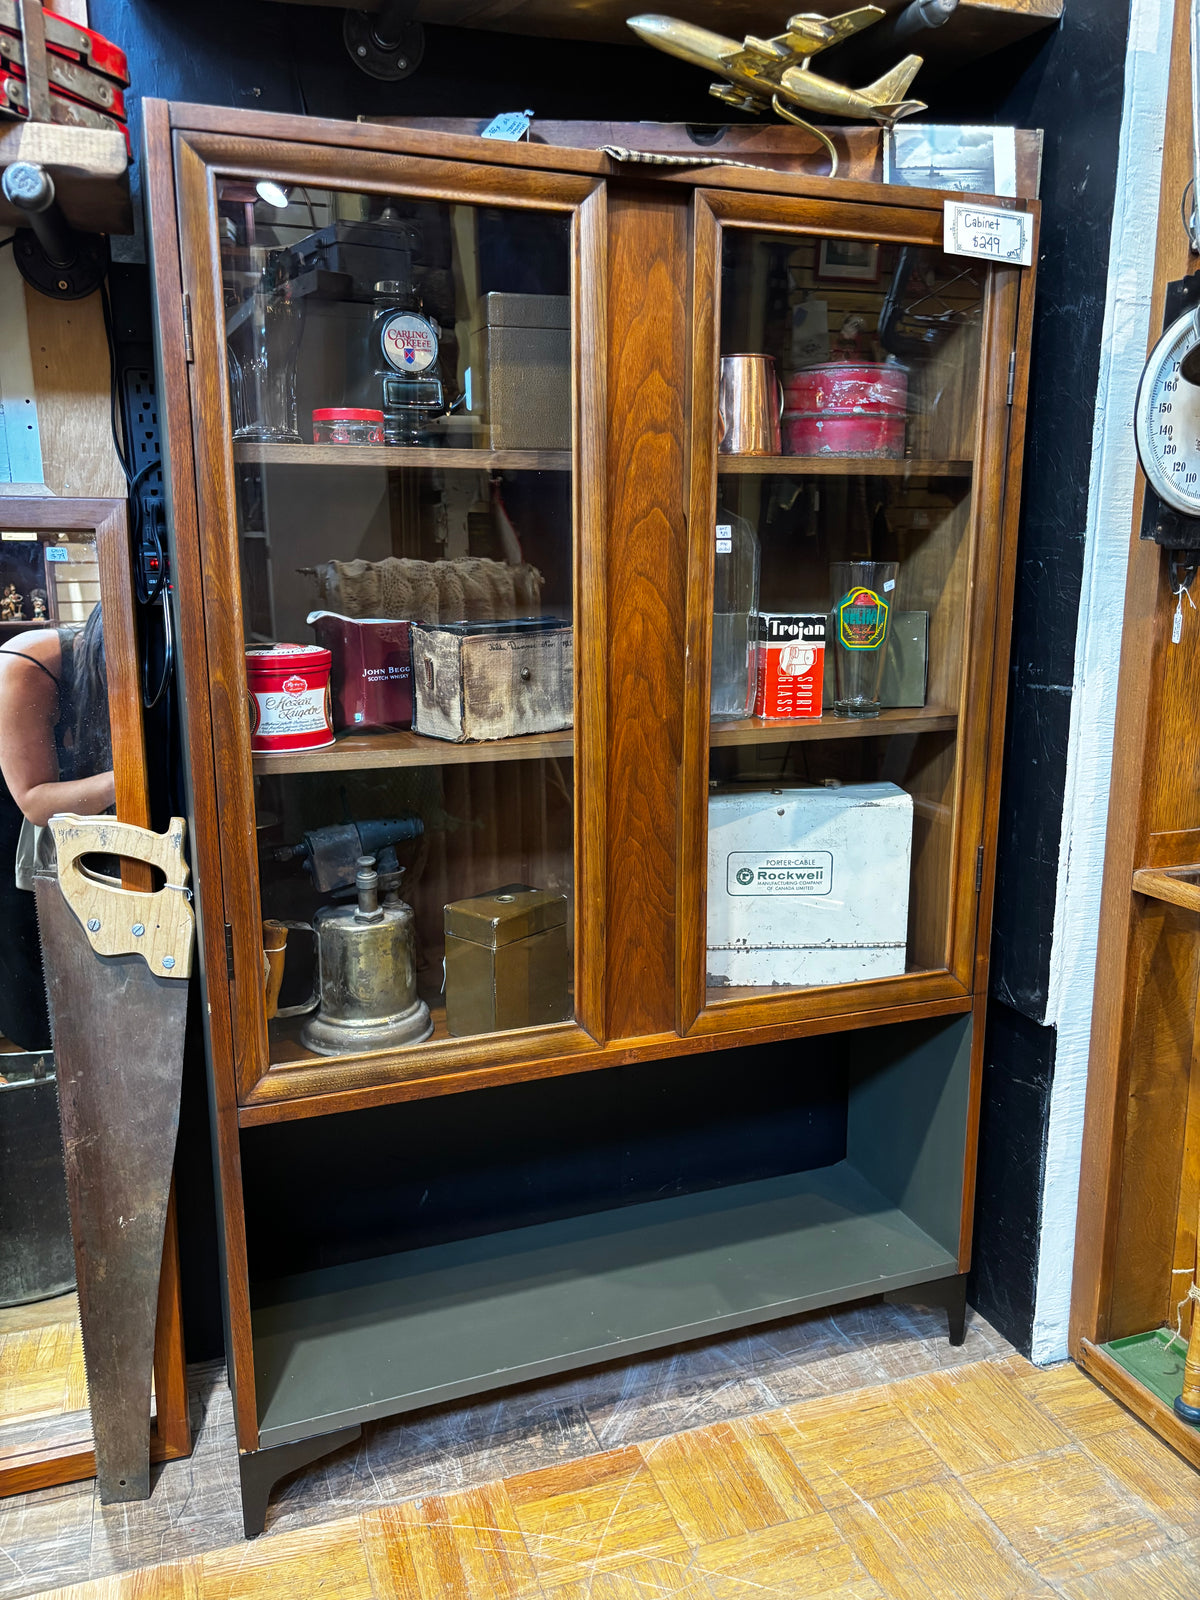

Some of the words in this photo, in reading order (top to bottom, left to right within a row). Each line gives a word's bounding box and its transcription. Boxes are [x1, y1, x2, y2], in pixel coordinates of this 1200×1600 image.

[964, 213, 1001, 231] Cabinet
[972, 235, 1000, 254] $249
[387, 328, 428, 341] CARLING
[1172, 361, 1181, 373] 17
[1164, 380, 1178, 392] 160
[1158, 402, 1173, 414] 150
[1159, 424, 1173, 436] 140
[1163, 444, 1177, 455] 130
[1173, 461, 1187, 472] 120
[1185, 472, 1197, 483] 110
[769, 620, 825, 640] Trojan
[362, 668, 386, 678] JOHN
[388, 666, 411, 674] BEGG
[776, 676, 794, 712] GLASS
[796, 676, 814, 712] SPORT
[757, 870, 824, 880] Rockwell
